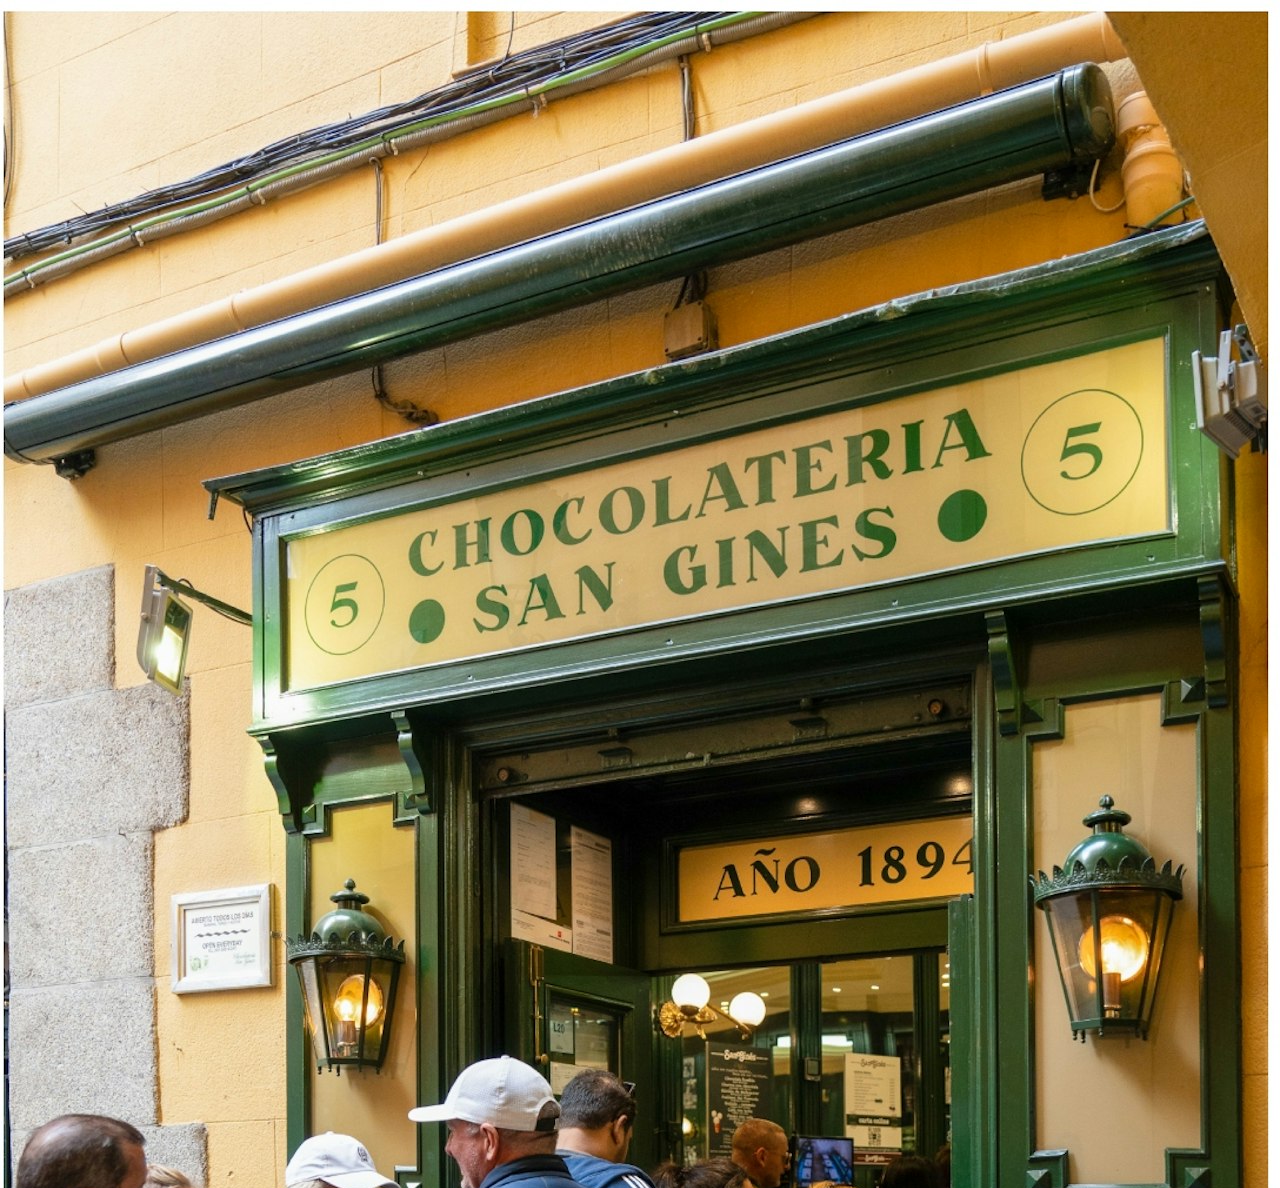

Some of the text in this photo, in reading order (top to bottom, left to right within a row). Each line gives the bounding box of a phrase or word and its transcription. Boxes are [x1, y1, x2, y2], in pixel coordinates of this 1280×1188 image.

[1058, 421, 1104, 481] 5
[408, 407, 993, 578] CHOCOLATERIA
[472, 505, 898, 634] SAN GINES
[328, 582, 360, 631] 5
[713, 838, 974, 900] AÑO 1894
